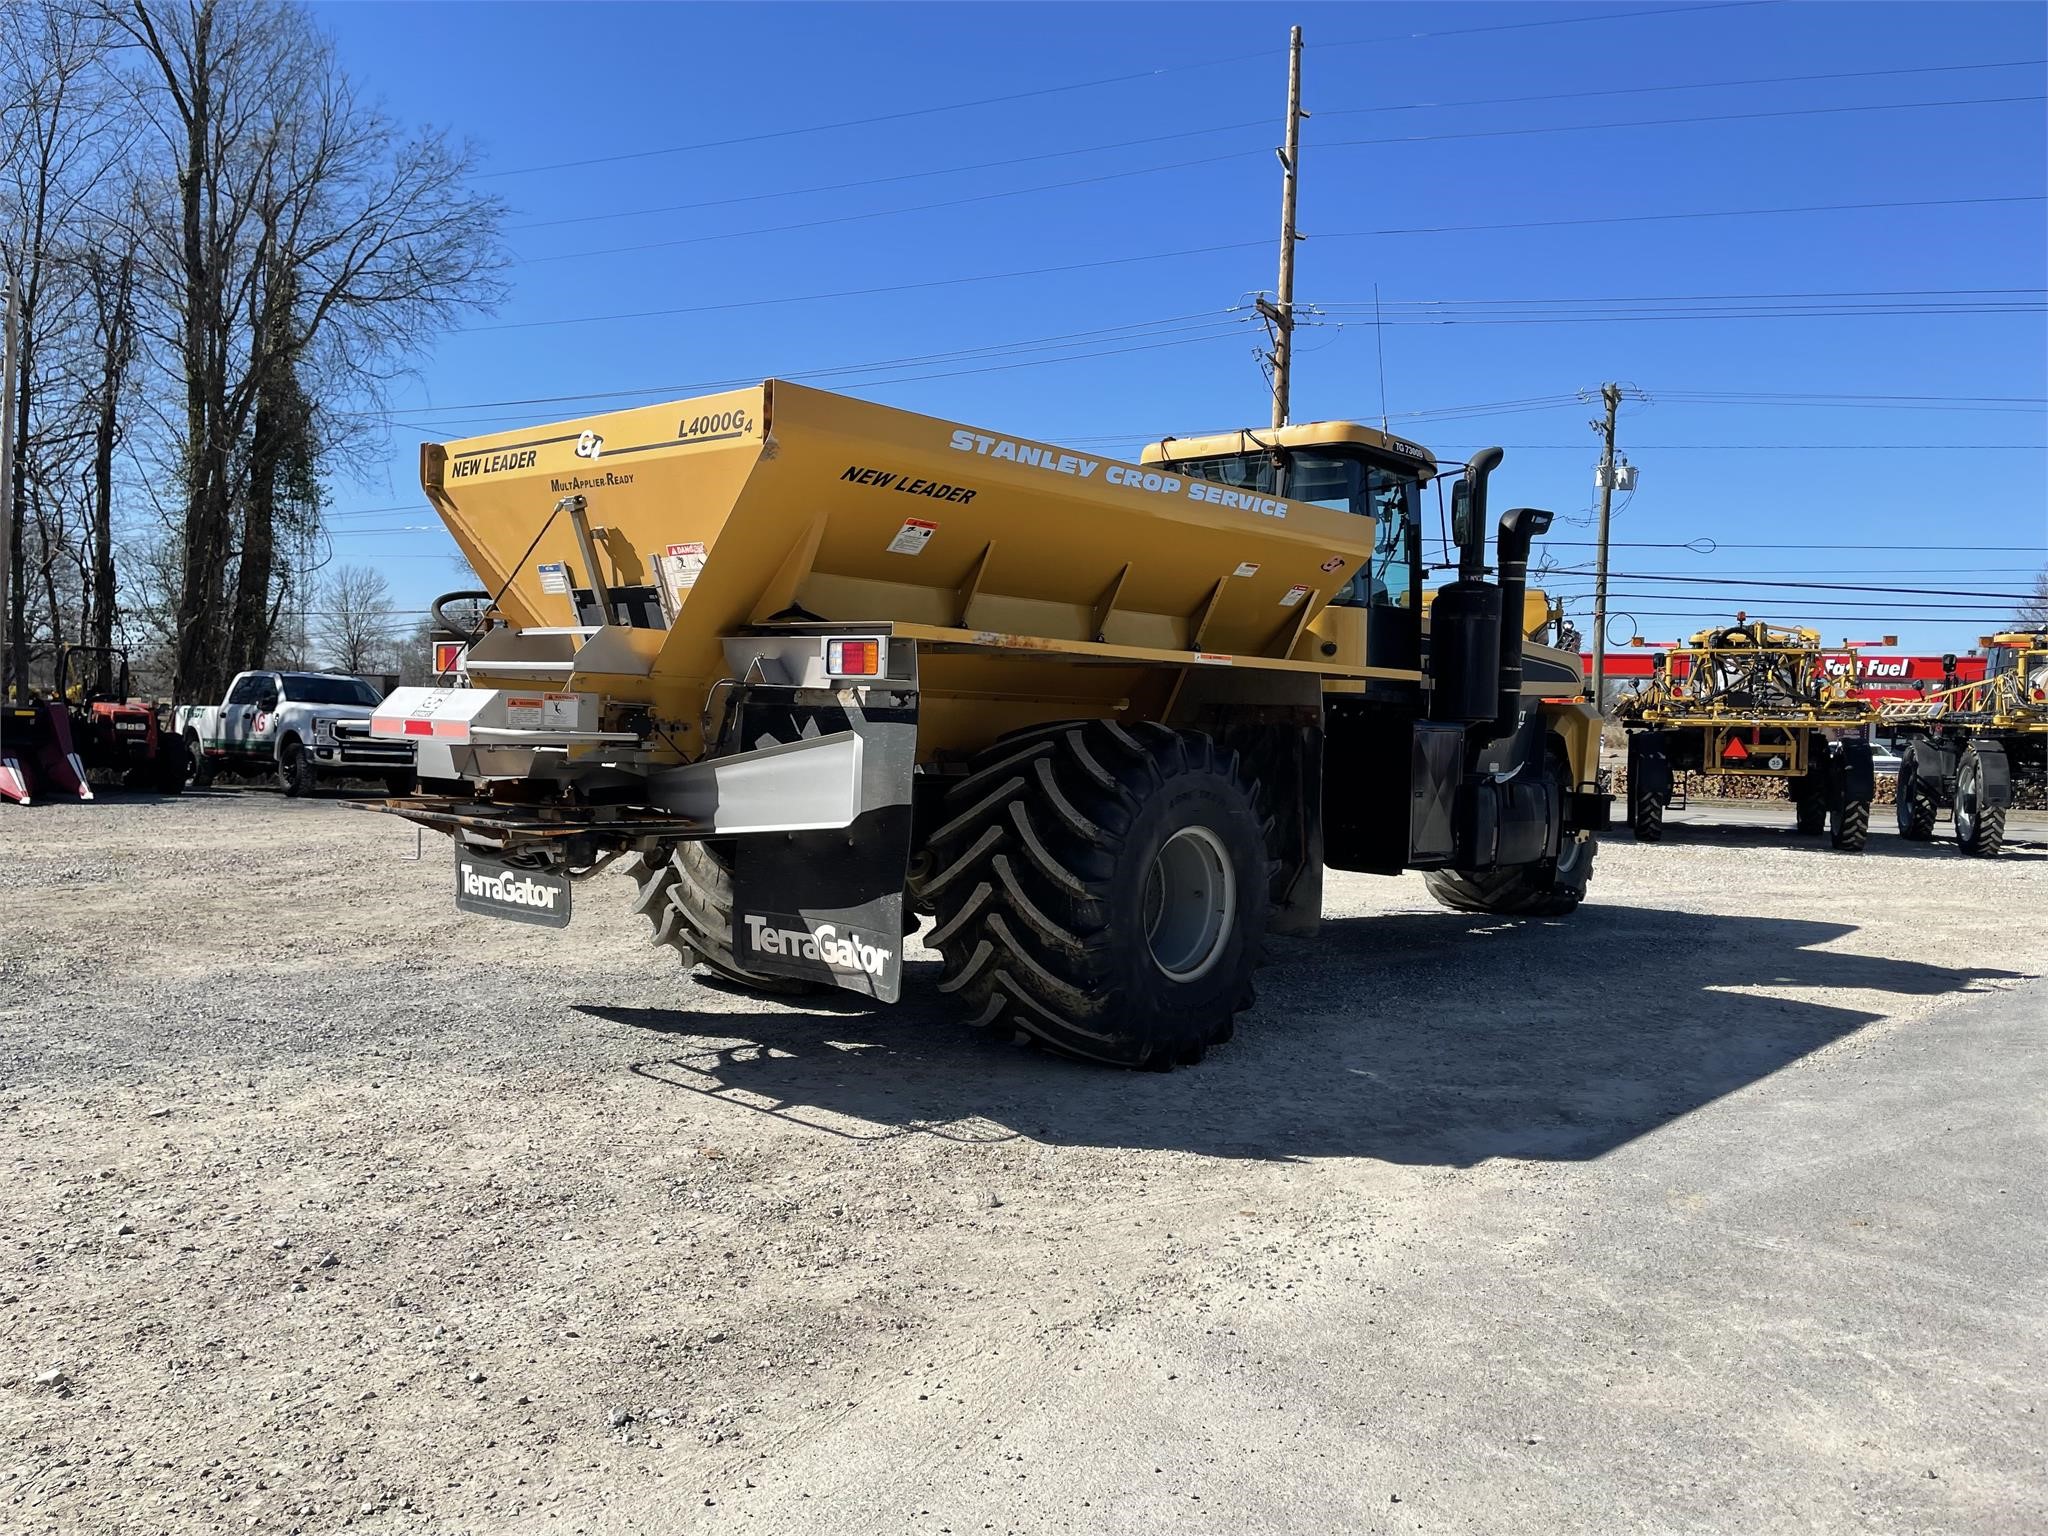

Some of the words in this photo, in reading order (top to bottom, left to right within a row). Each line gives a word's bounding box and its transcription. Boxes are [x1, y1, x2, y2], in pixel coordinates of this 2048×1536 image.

[451, 458, 482, 478] NEW
[483, 450, 537, 474] LEADER
[840, 466, 898, 488] NEW
[894, 476, 977, 504] LEADER
[949, 429, 1099, 478] STANLEY
[1105, 465, 1181, 494] CROP
[1187, 482, 1289, 519] SERVICE
[1867, 658, 1909, 677] Fuel
[460, 863, 559, 909] TerraGator
[744, 914, 890, 977] TerraGator
